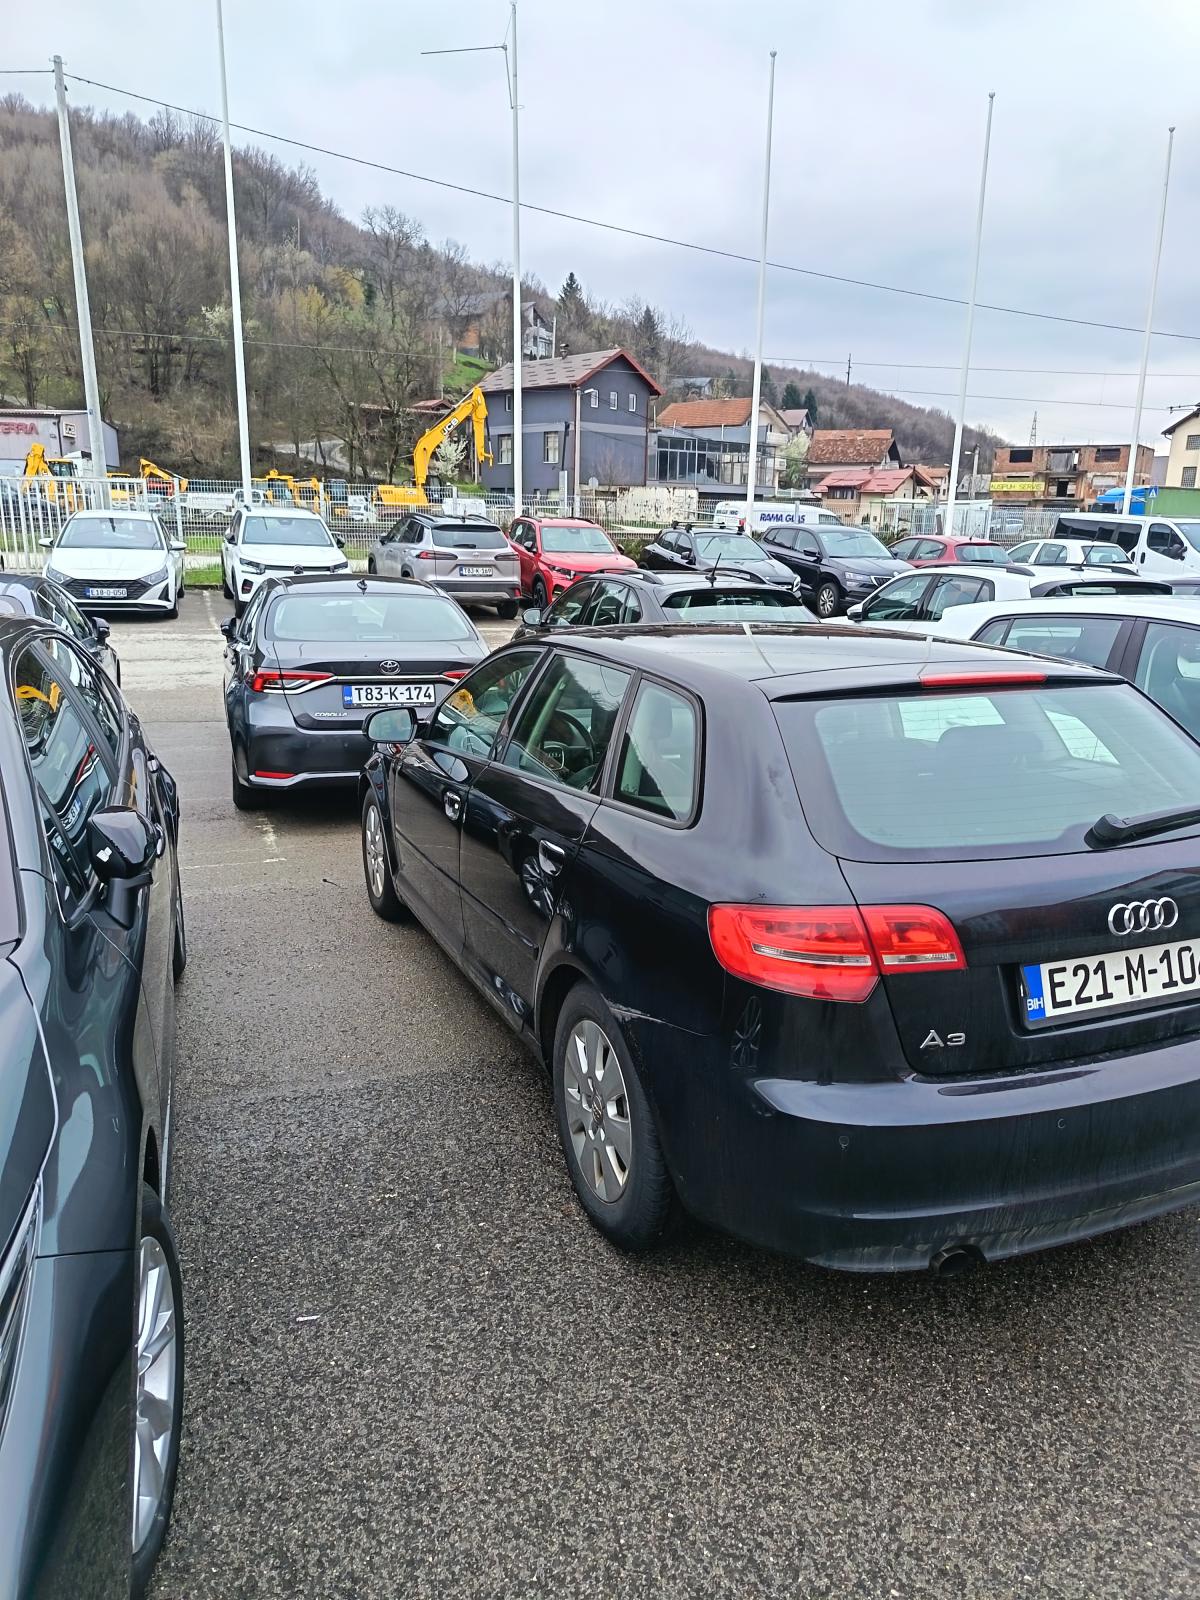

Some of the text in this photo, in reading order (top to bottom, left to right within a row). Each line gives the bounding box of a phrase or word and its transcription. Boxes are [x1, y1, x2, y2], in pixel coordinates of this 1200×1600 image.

[442, 417, 459, 435] JCB
[760, 513, 784, 522] RAMA
[354, 686, 432, 702] T83-K-174
[1026, 945, 1200, 1011] BIH E21-M-10
[920, 1029, 966, 1049] A3
